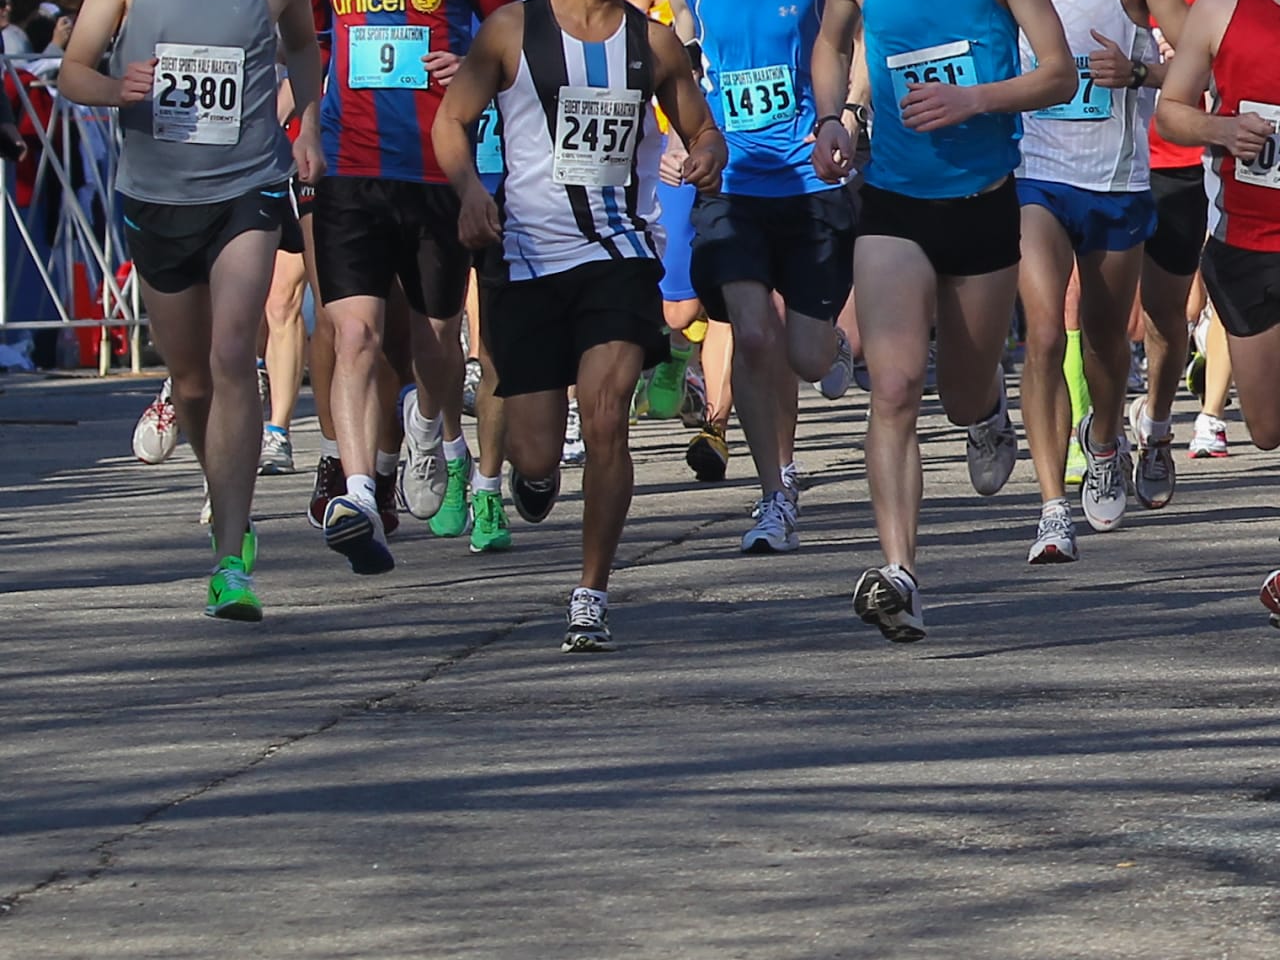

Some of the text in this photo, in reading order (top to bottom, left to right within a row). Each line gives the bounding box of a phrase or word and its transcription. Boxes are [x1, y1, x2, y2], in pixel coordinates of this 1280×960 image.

[367, 28, 389, 40] SPORTS
[391, 28, 423, 40] MARATHON
[380, 43, 394, 73] 9
[753, 67, 785, 82] MARATHON
[159, 73, 236, 110] 2380
[725, 81, 790, 117] 1435
[562, 116, 634, 152] 2457
